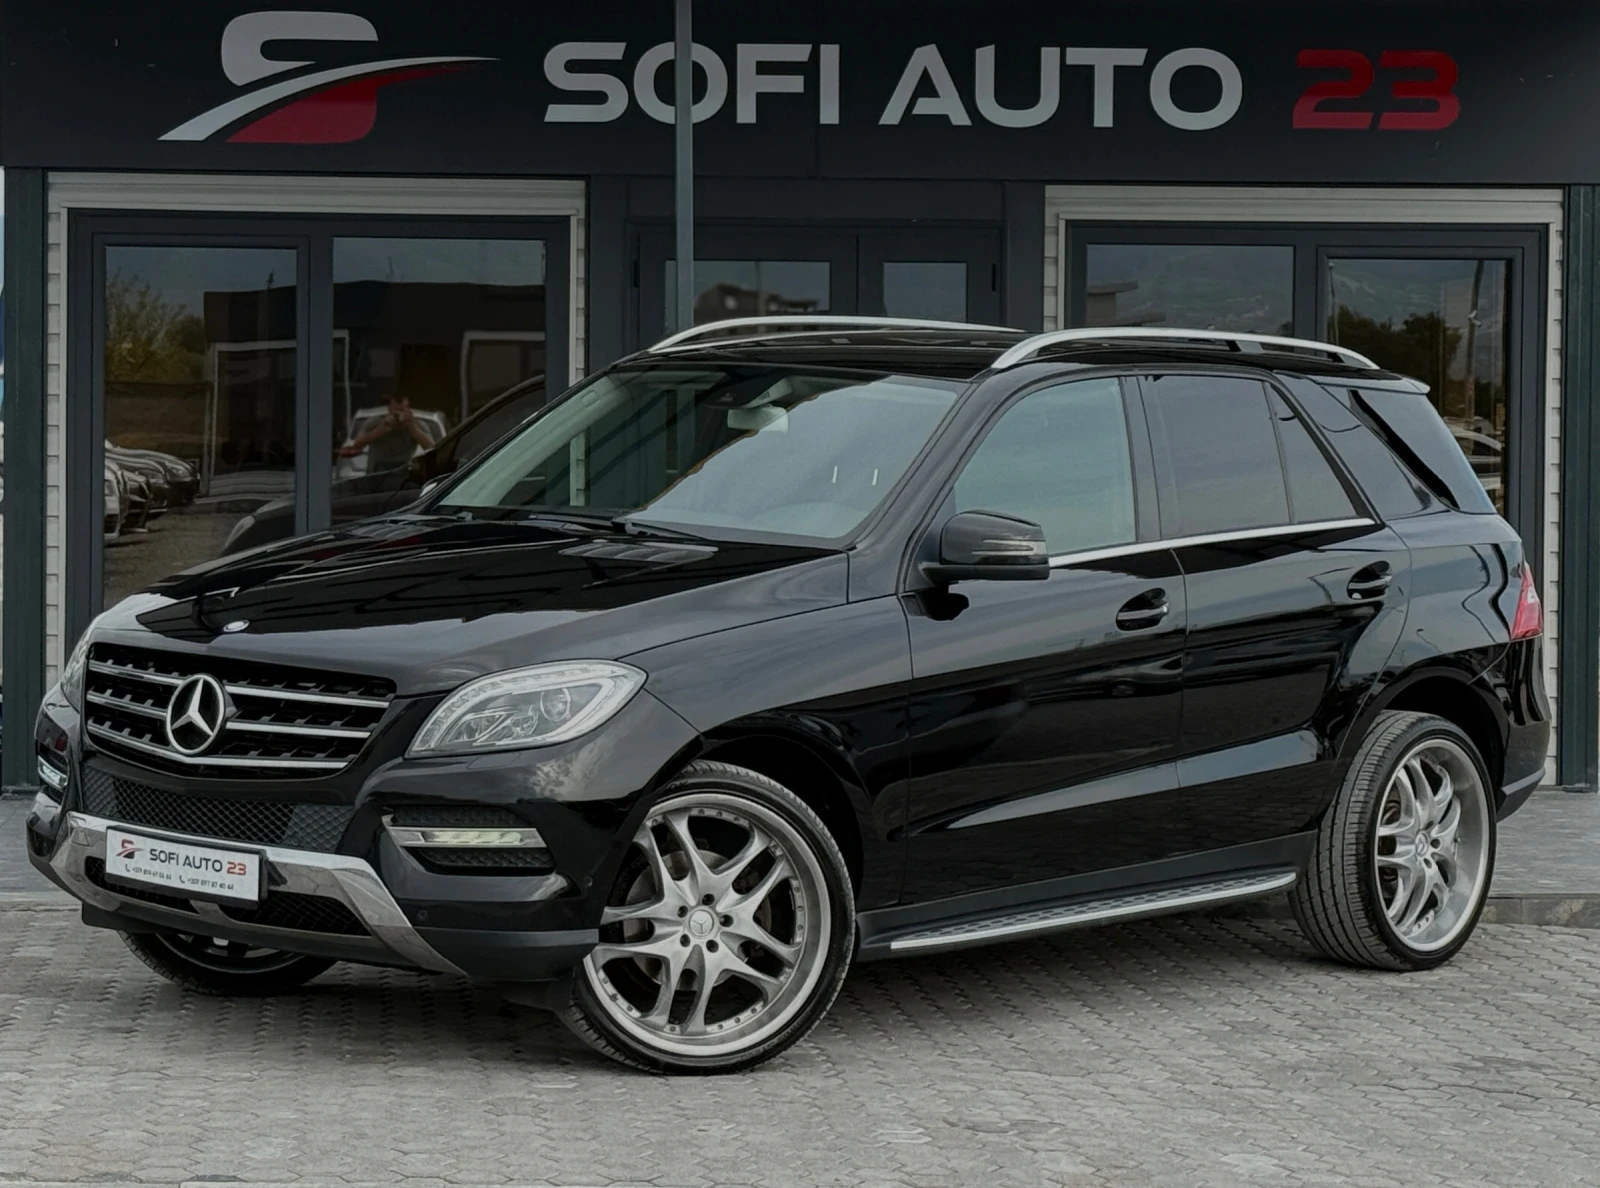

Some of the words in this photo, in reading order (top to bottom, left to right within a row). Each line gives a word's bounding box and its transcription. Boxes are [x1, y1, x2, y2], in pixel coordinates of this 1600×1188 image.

[543, 41, 840, 125] SOFI
[878, 44, 1243, 131] AUTO
[1292, 49, 1461, 131] 23
[149, 848, 180, 866] SOFI
[182, 855, 223, 873] AUTO
[226, 861, 247, 876] 23
